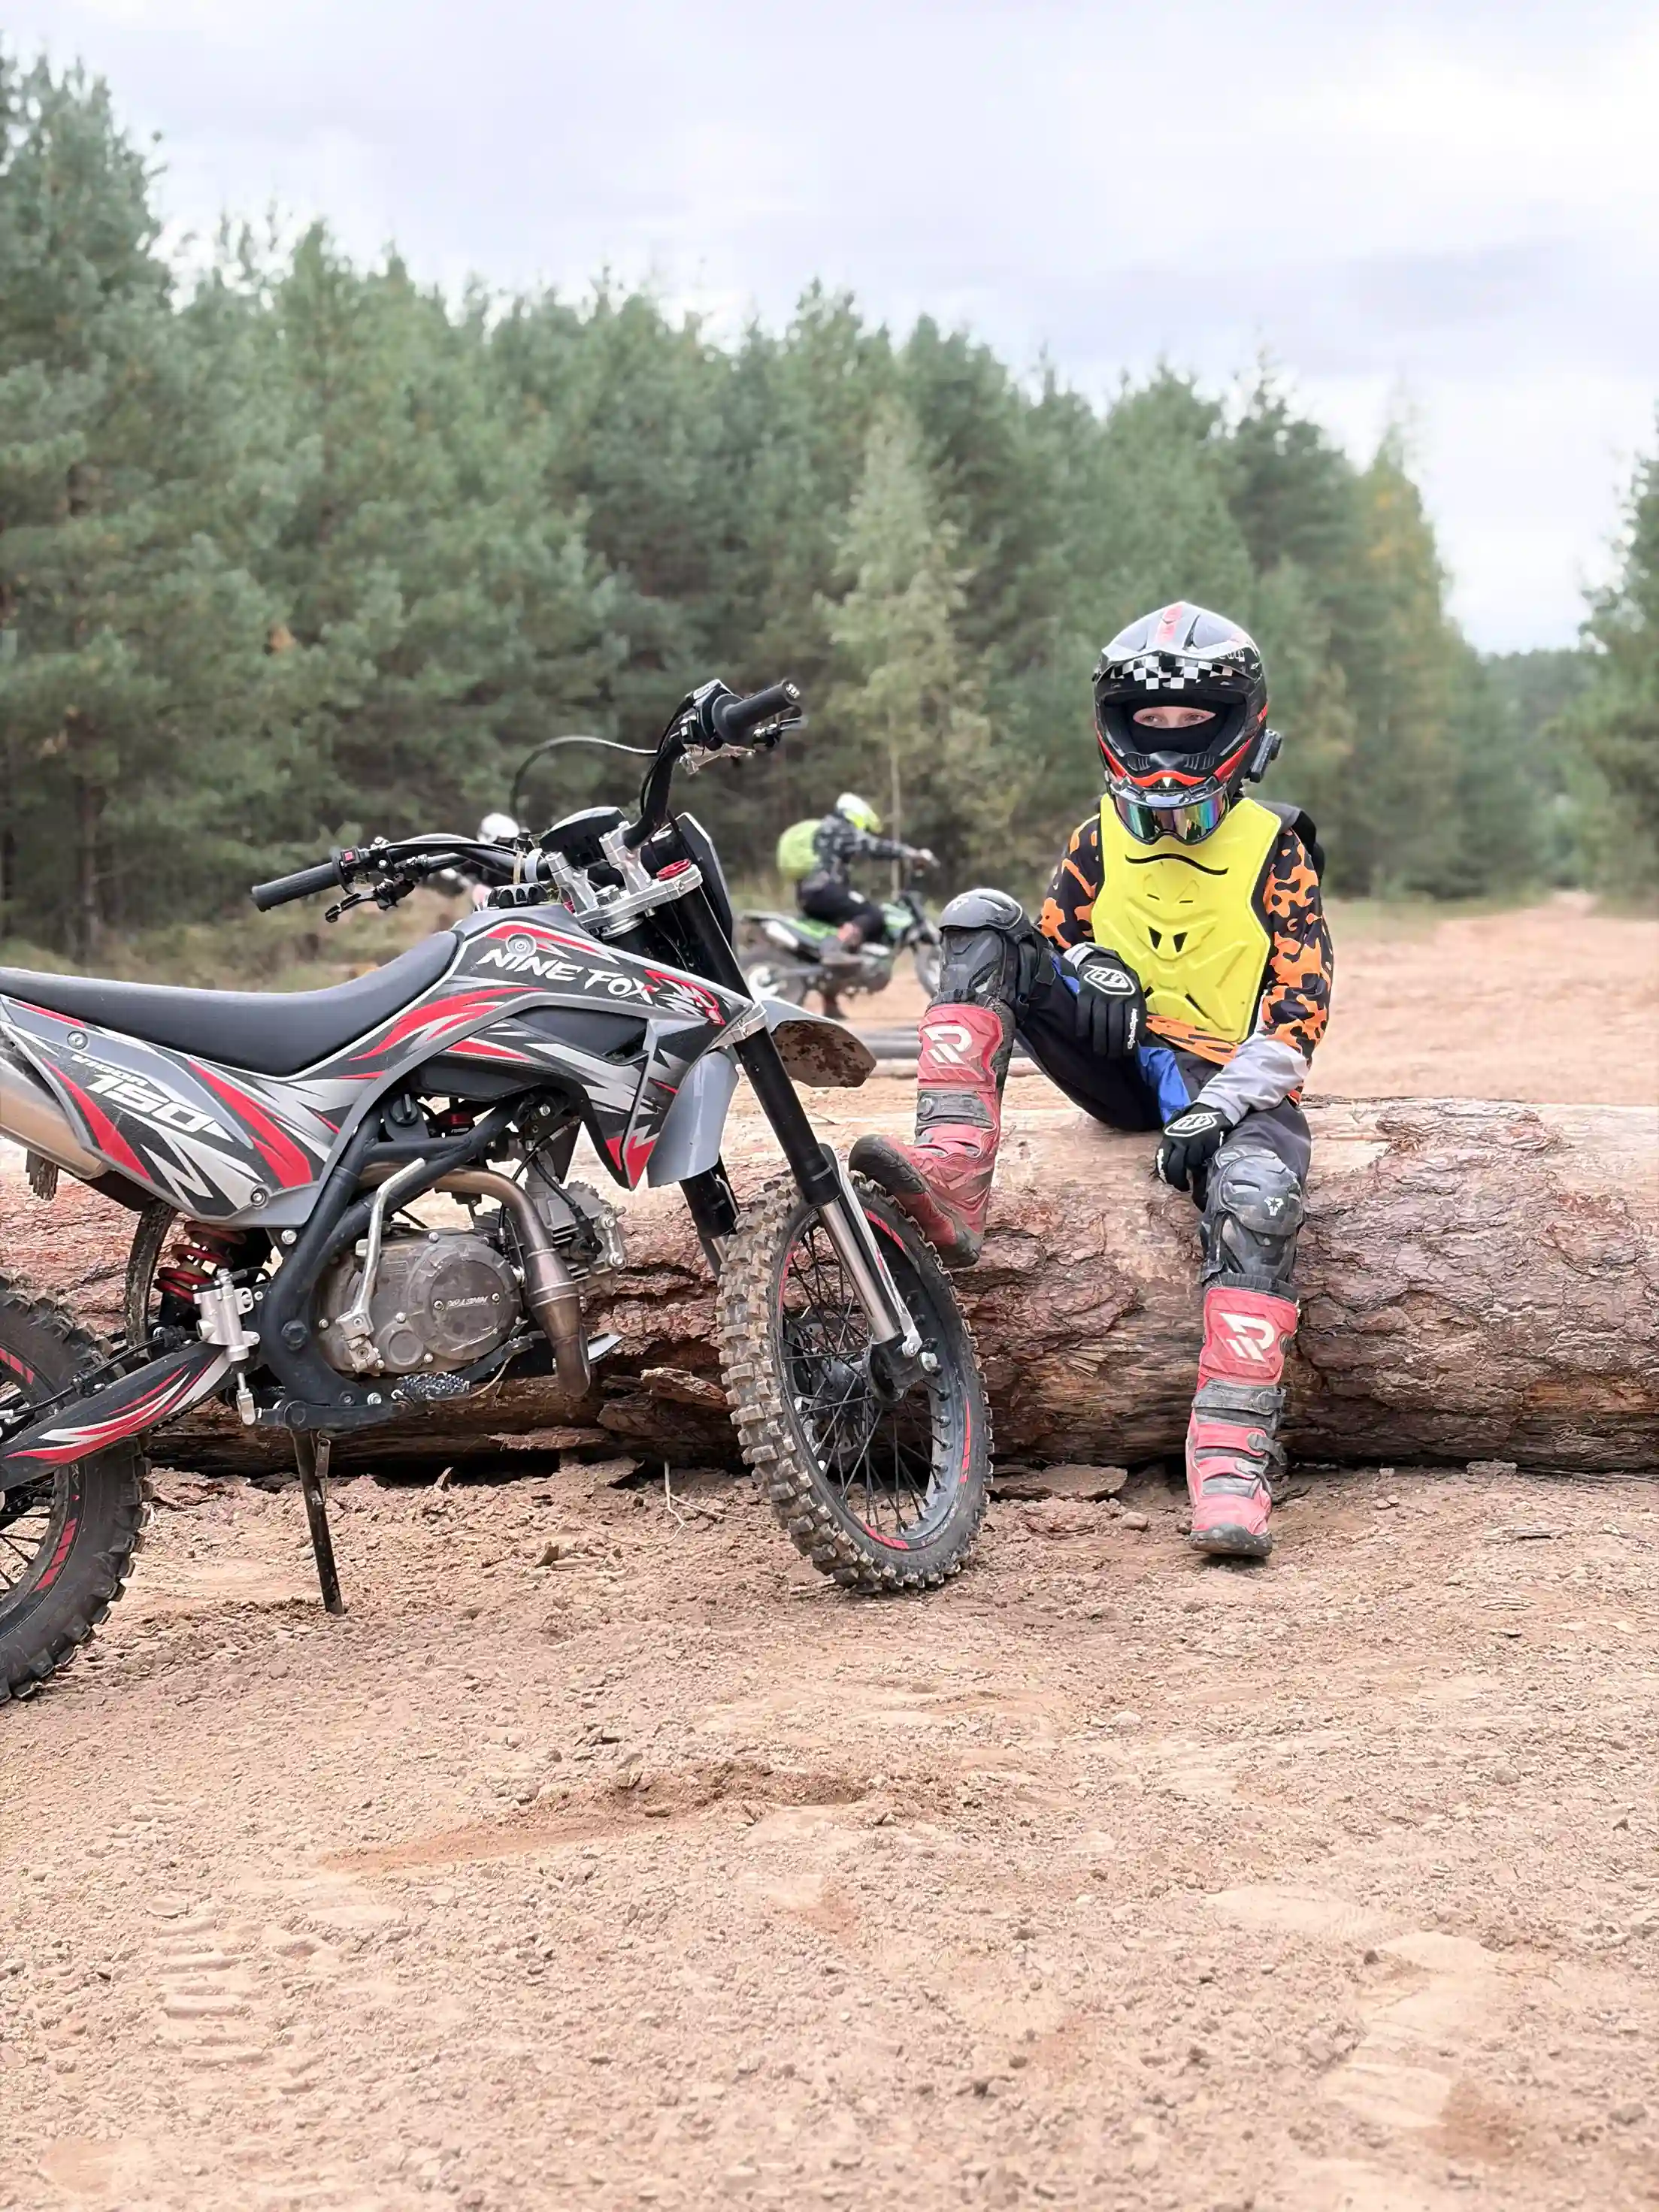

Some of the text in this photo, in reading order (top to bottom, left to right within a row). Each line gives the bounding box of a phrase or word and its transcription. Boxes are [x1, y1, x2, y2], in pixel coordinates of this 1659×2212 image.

[476, 949, 655, 1005] NINE FOX
[86, 1073, 216, 1133] 150
